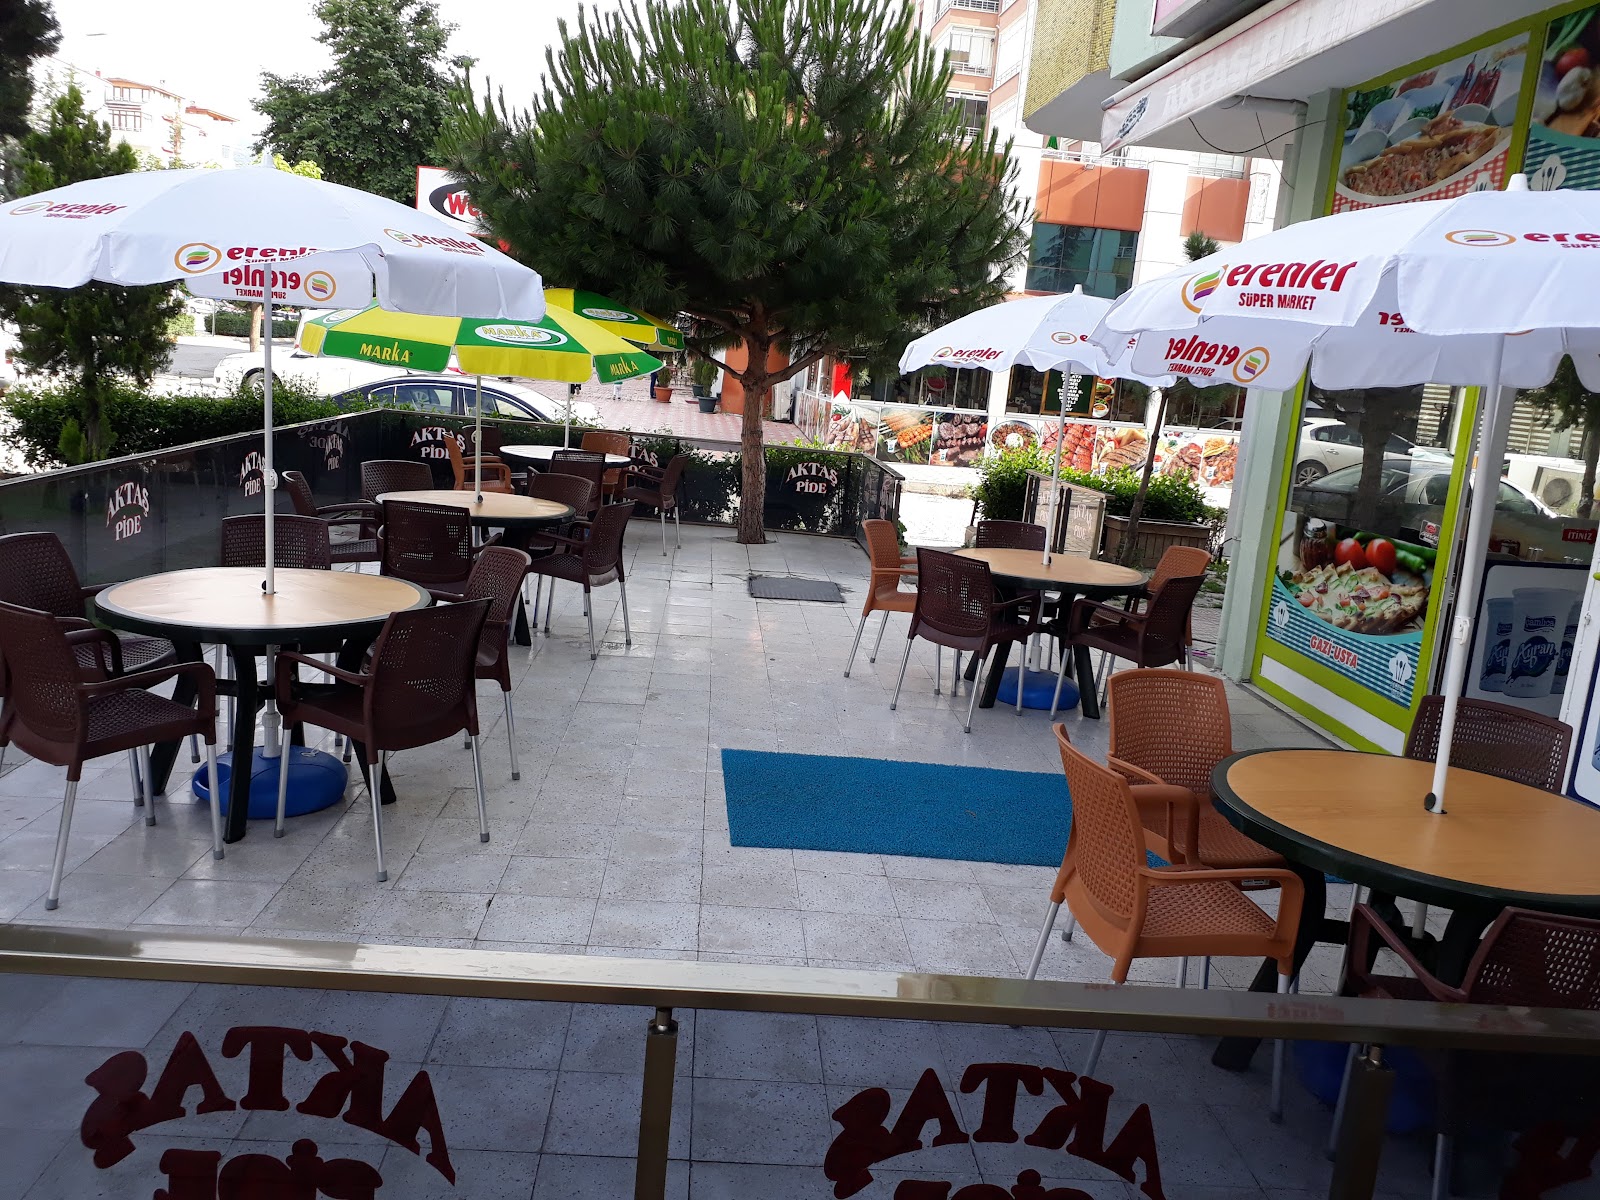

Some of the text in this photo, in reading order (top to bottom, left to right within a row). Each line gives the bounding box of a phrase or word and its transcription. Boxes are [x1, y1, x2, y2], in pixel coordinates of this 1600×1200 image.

[1226, 259, 1358, 292] erenler
[1239, 292, 1317, 311] SÜPER MARKET
[785, 462, 837, 487] AKTAŞ
[796, 479, 827, 494] PİDE
[106, 482, 149, 528] AKTAŞ
[116, 515, 141, 541] PİDE
